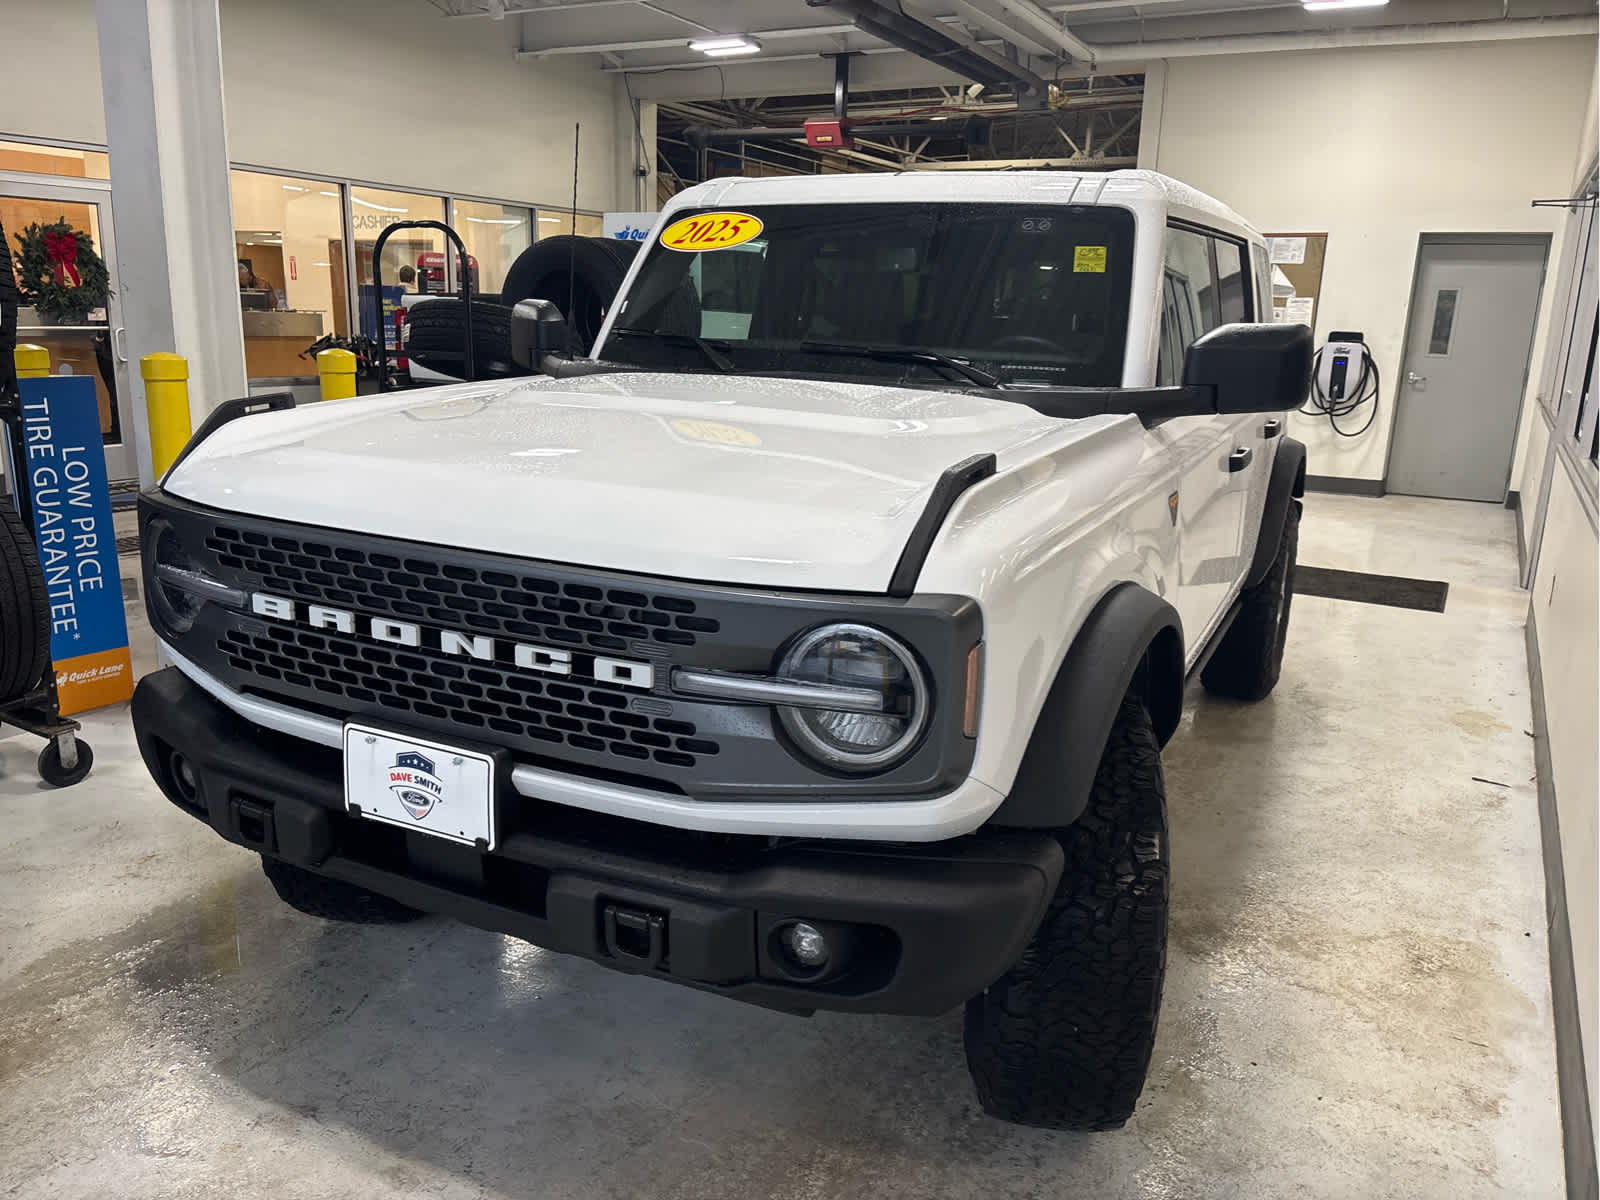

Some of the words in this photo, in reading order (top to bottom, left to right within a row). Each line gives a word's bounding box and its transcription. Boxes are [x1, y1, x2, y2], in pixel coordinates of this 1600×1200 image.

[630, 228, 651, 241] Qui
[672, 219, 750, 244] 2025
[24, 397, 55, 459] TIRE
[62, 446, 93, 508] LOW
[72, 517, 103, 592] PRICE
[252, 591, 654, 689] BRONCO
[69, 667, 98, 682] Quick
[98, 663, 124, 675] Lane
[390, 771, 413, 783] DAVE
[414, 775, 442, 795] SMITH
